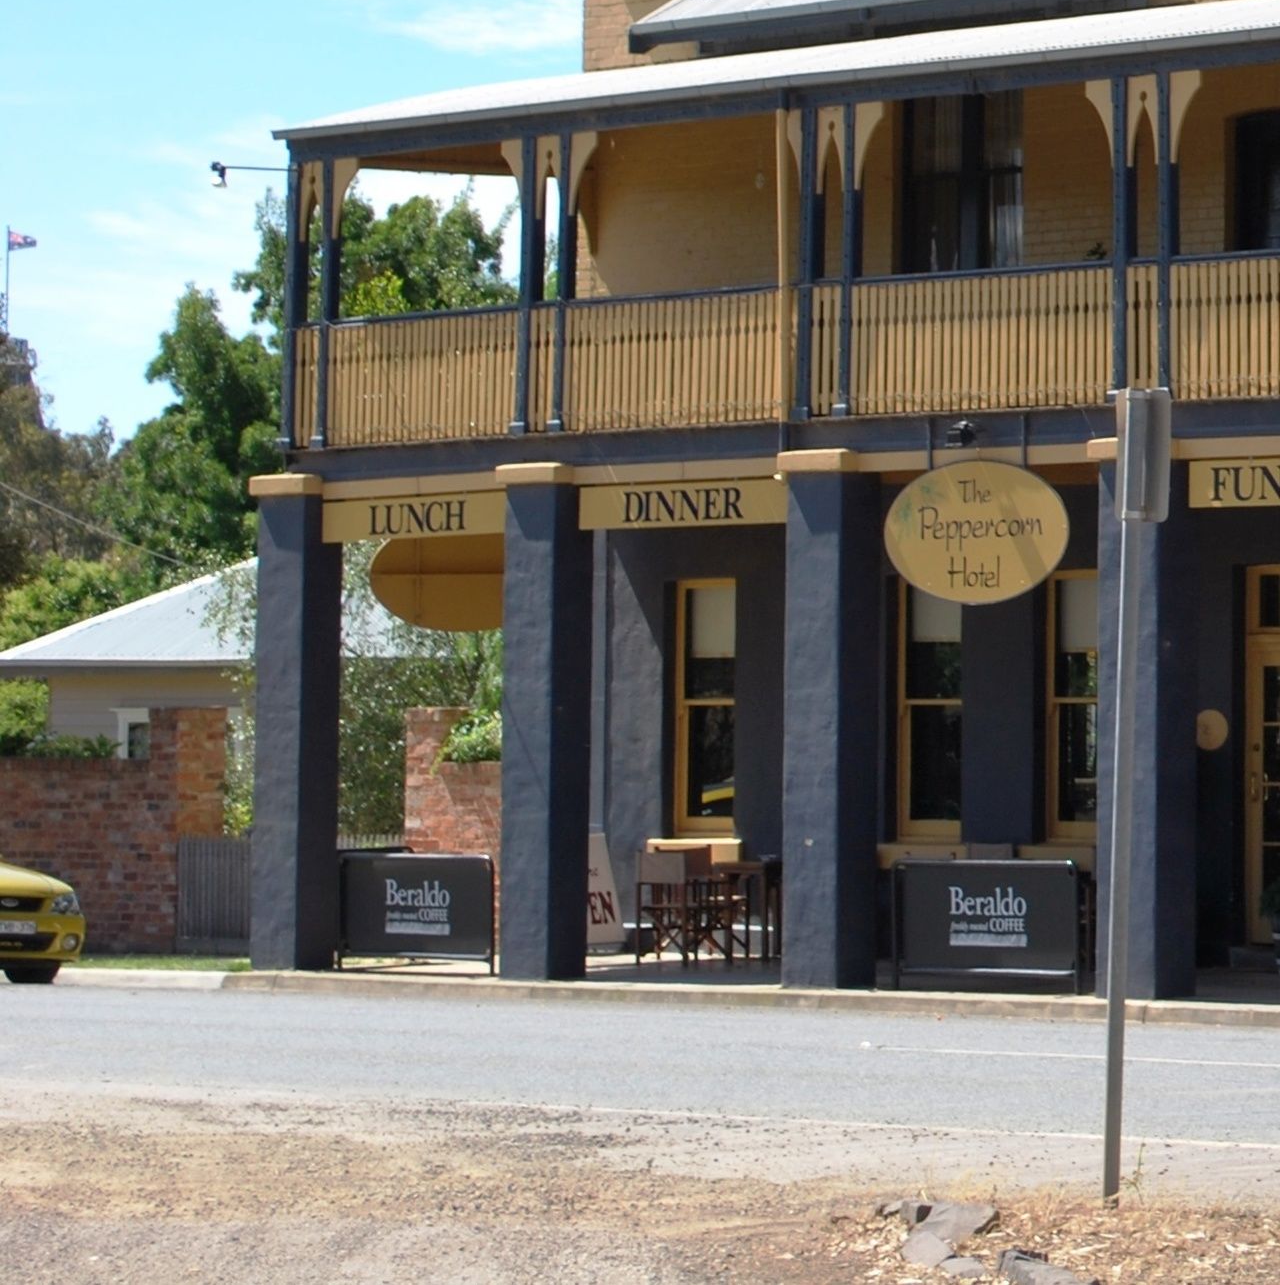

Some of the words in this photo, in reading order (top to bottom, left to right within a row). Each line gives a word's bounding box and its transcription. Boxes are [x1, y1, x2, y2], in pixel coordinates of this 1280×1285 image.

[622, 487, 744, 523] DINNER
[958, 479, 992, 503] The
[368, 500, 466, 536] LUNCH
[918, 506, 1043, 551] Peppercorn
[947, 555, 1001, 588] Hotel
[385, 878, 451, 907] Beraldo
[948, 886, 1027, 916] Beraldo
[989, 918, 1025, 932] COFFEE
